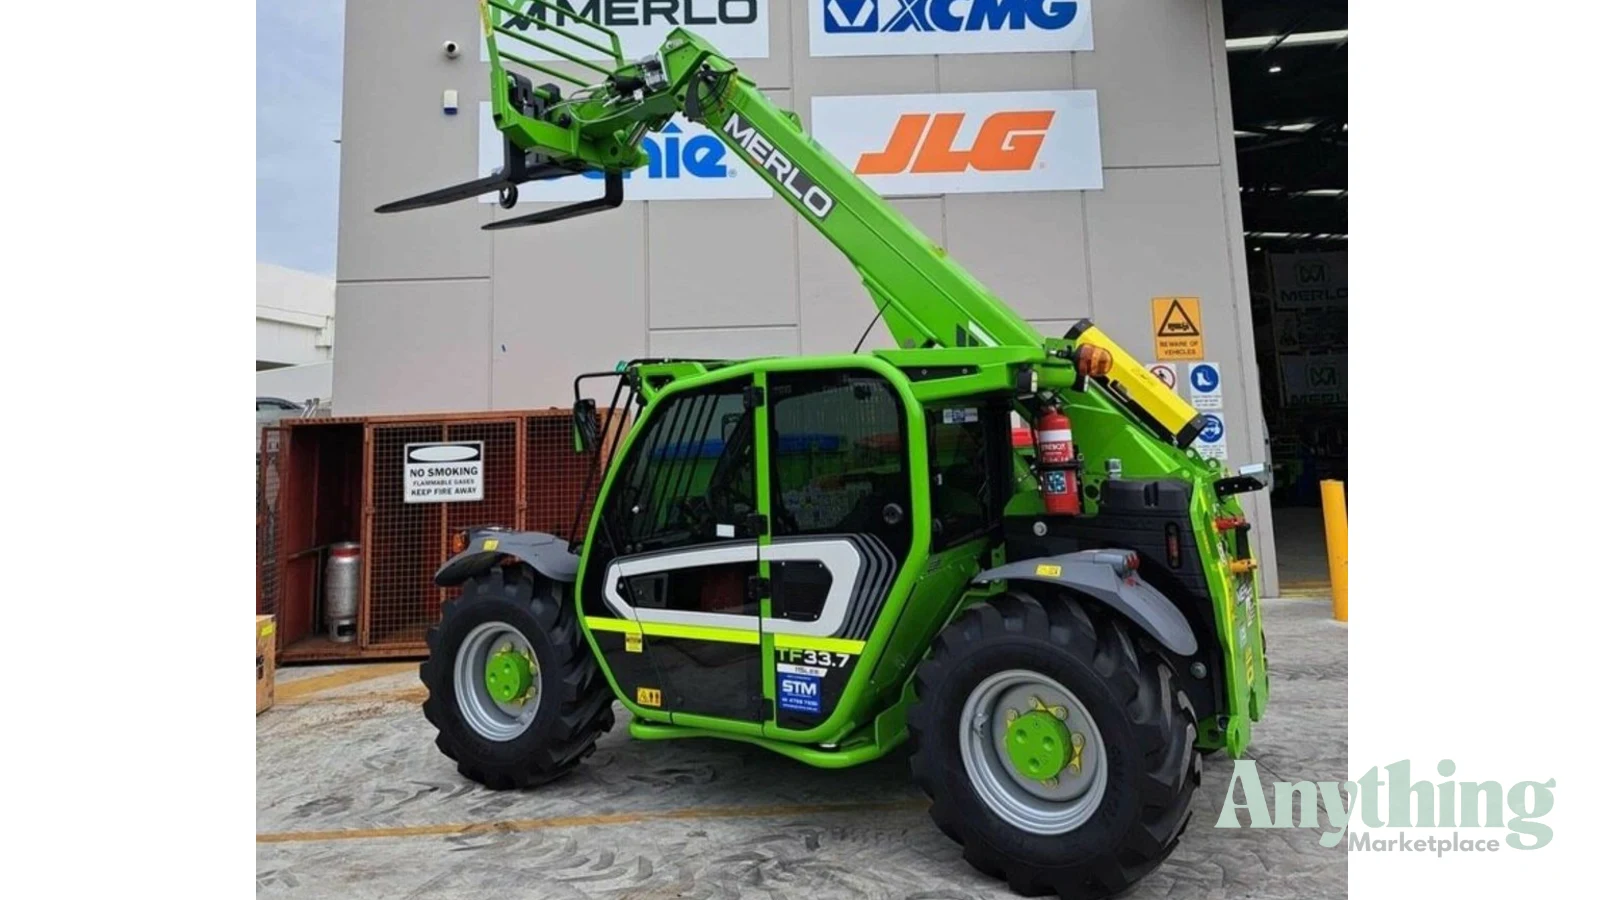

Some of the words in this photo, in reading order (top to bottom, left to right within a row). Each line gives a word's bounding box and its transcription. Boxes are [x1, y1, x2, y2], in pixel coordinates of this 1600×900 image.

[556, 0, 758, 26] MERLO
[879, 0, 1078, 32] XCMG
[853, 110, 1056, 175] JLG
[723, 112, 833, 218] MERLO
[410, 468, 425, 478] NO
[427, 466, 478, 477] SMOKING
[411, 488, 432, 496] KEEP
[434, 487, 452, 495] FIRE
[775, 648, 850, 668] TF33.7
[782, 679, 817, 696] STM
